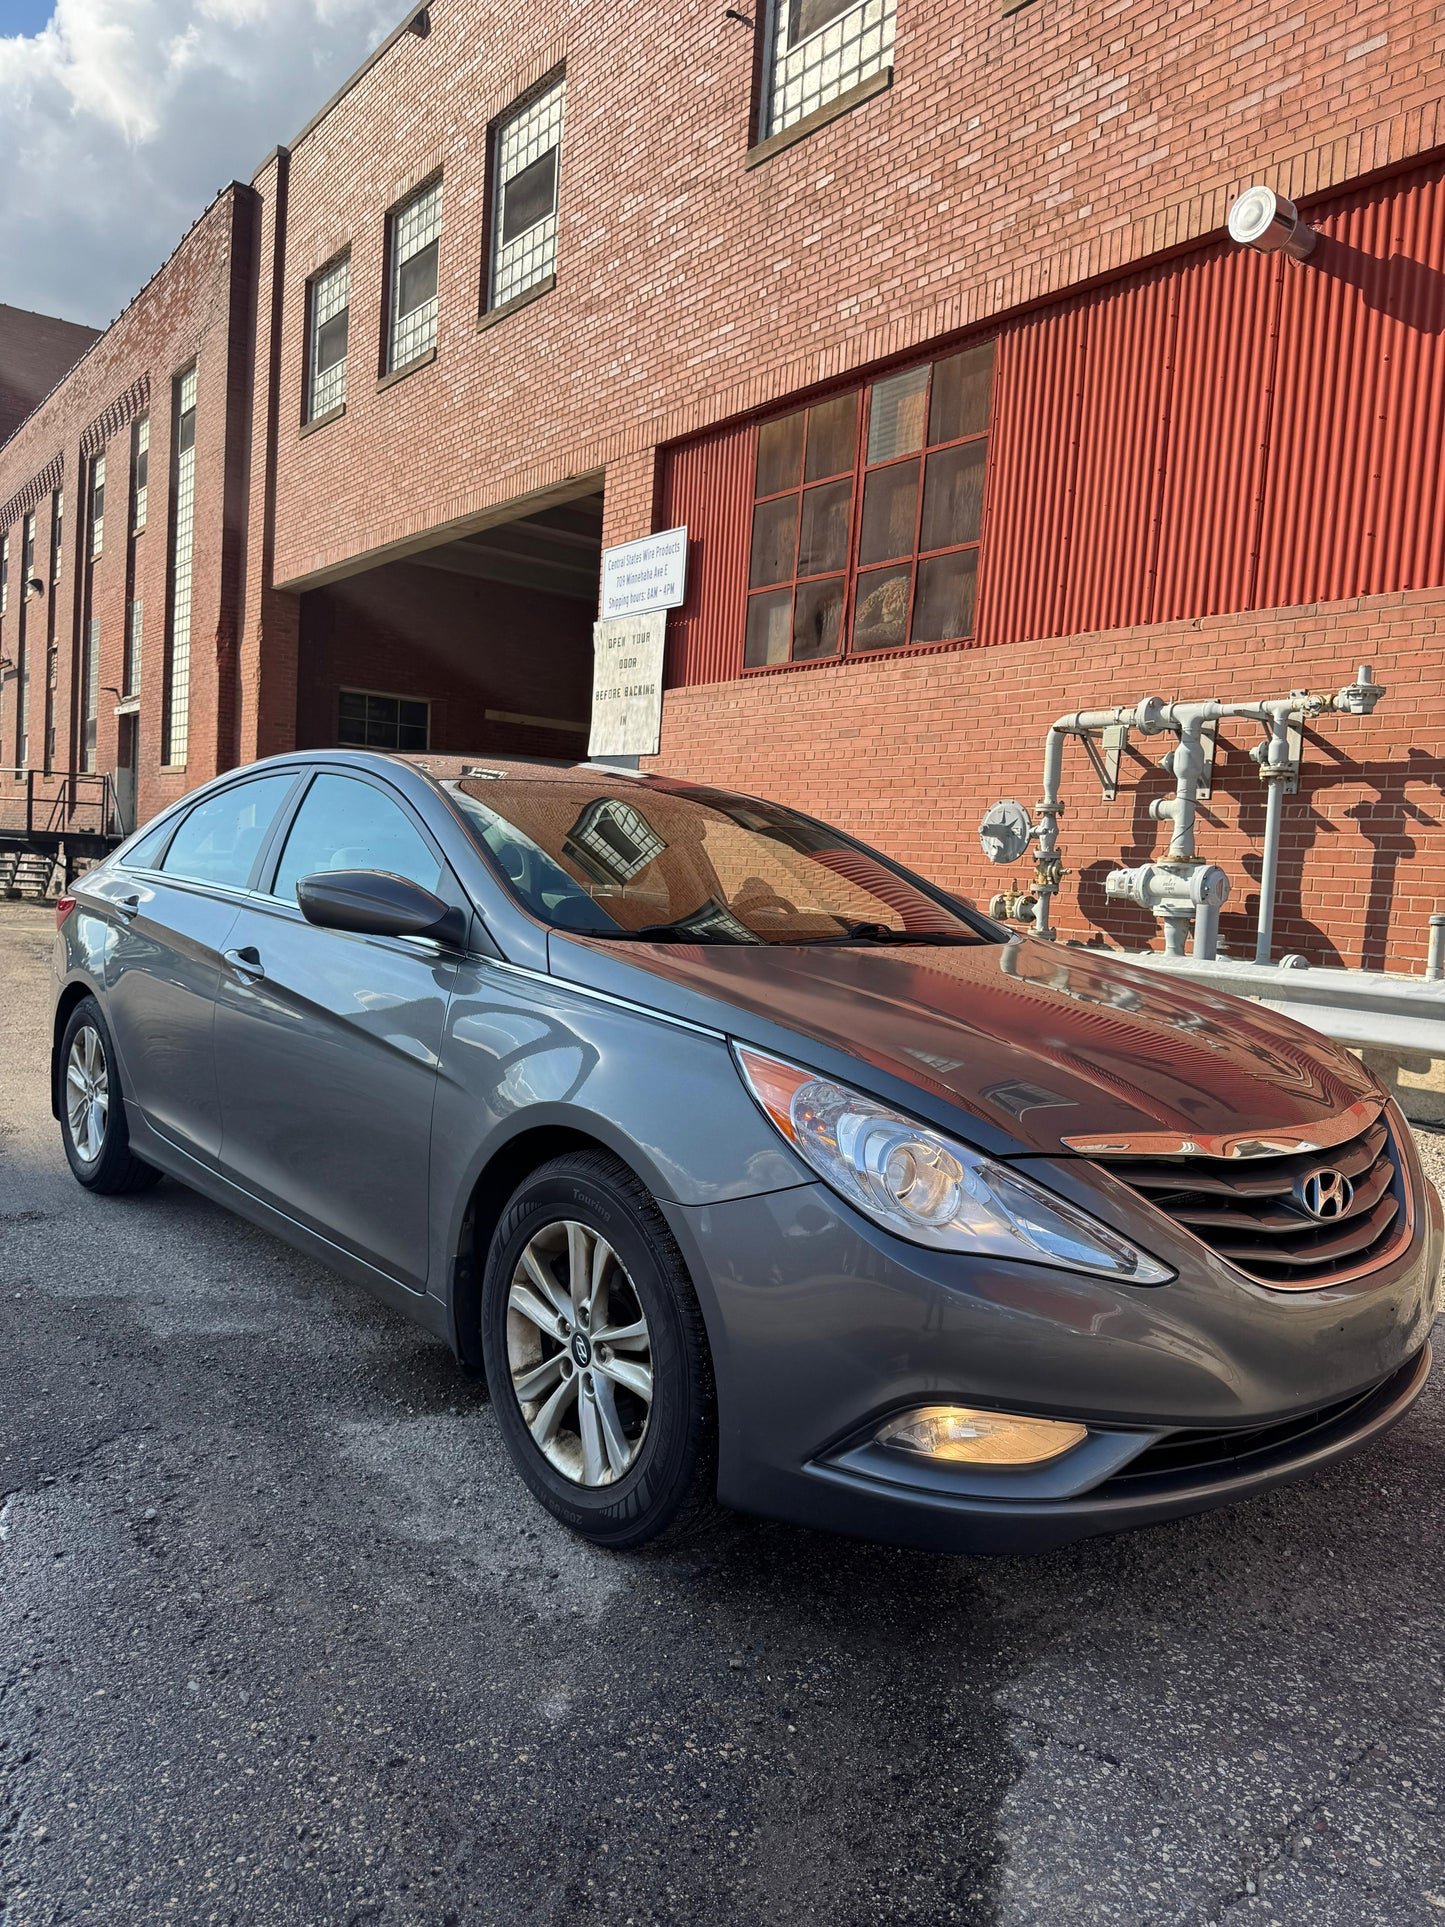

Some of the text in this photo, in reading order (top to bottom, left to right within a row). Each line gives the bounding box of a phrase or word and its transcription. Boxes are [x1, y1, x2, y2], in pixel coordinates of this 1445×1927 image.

[608, 542, 680, 571] Central States Wire Products
[653, 566, 664, 578] Ave
[664, 563, 668, 576] E
[608, 594, 629, 610] Shipping
[663, 582, 675, 596] 4PM
[608, 631, 651, 649] OPEN YOUR
[619, 657, 637, 669] DOOR
[595, 684, 655, 701] BEFORE BACKING
[619, 715, 627, 726] IN
[573, 1188, 611, 1222] Touring
